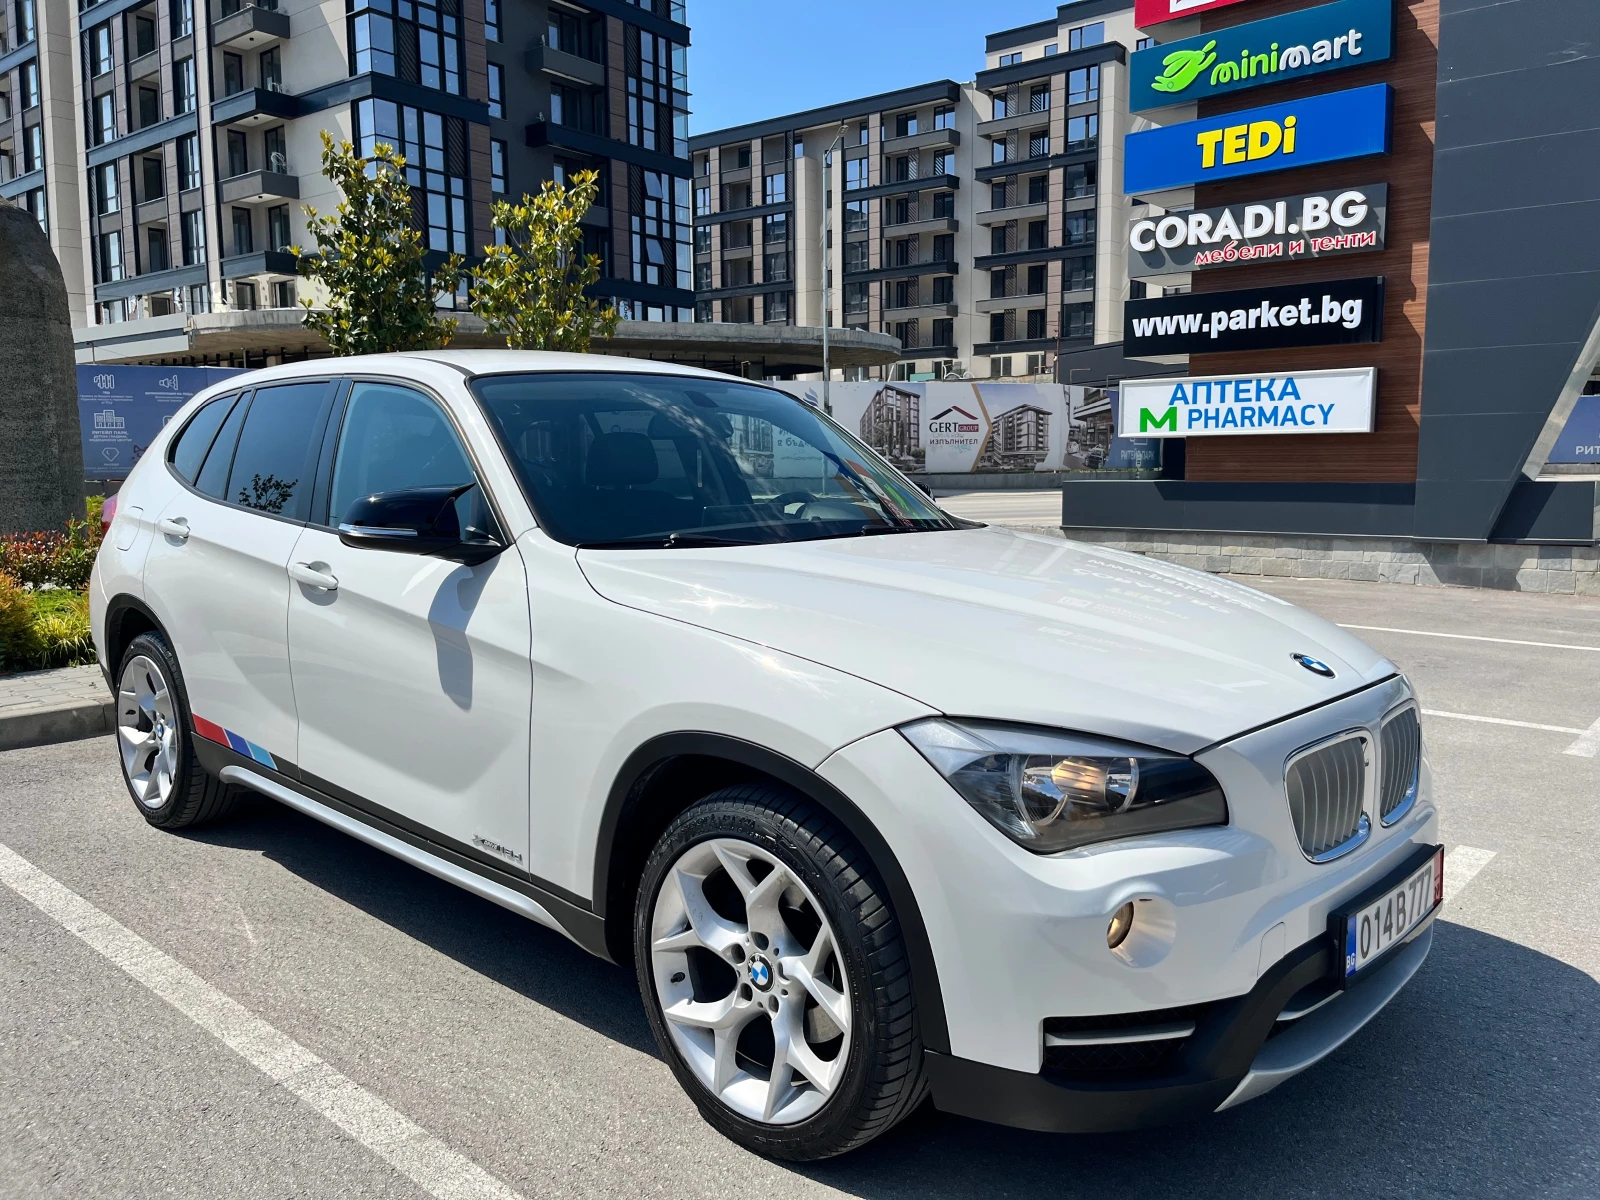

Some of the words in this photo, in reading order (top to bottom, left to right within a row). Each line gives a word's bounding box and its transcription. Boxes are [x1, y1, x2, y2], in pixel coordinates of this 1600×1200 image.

[1210, 29, 1362, 85] minimart
[1197, 115, 1297, 168] TEDi
[1129, 190, 1368, 252] CORADI.BG
[1195, 241, 1282, 265] мебели
[1289, 239, 1304, 255] и
[1311, 231, 1376, 251] тенти
[1132, 295, 1362, 338] www.parket.bg
[1169, 377, 1301, 405] АПТЕКА
[929, 422, 958, 433] GERT
[1187, 404, 1335, 429] PHARMACY
[1346, 952, 1356, 968] BG
